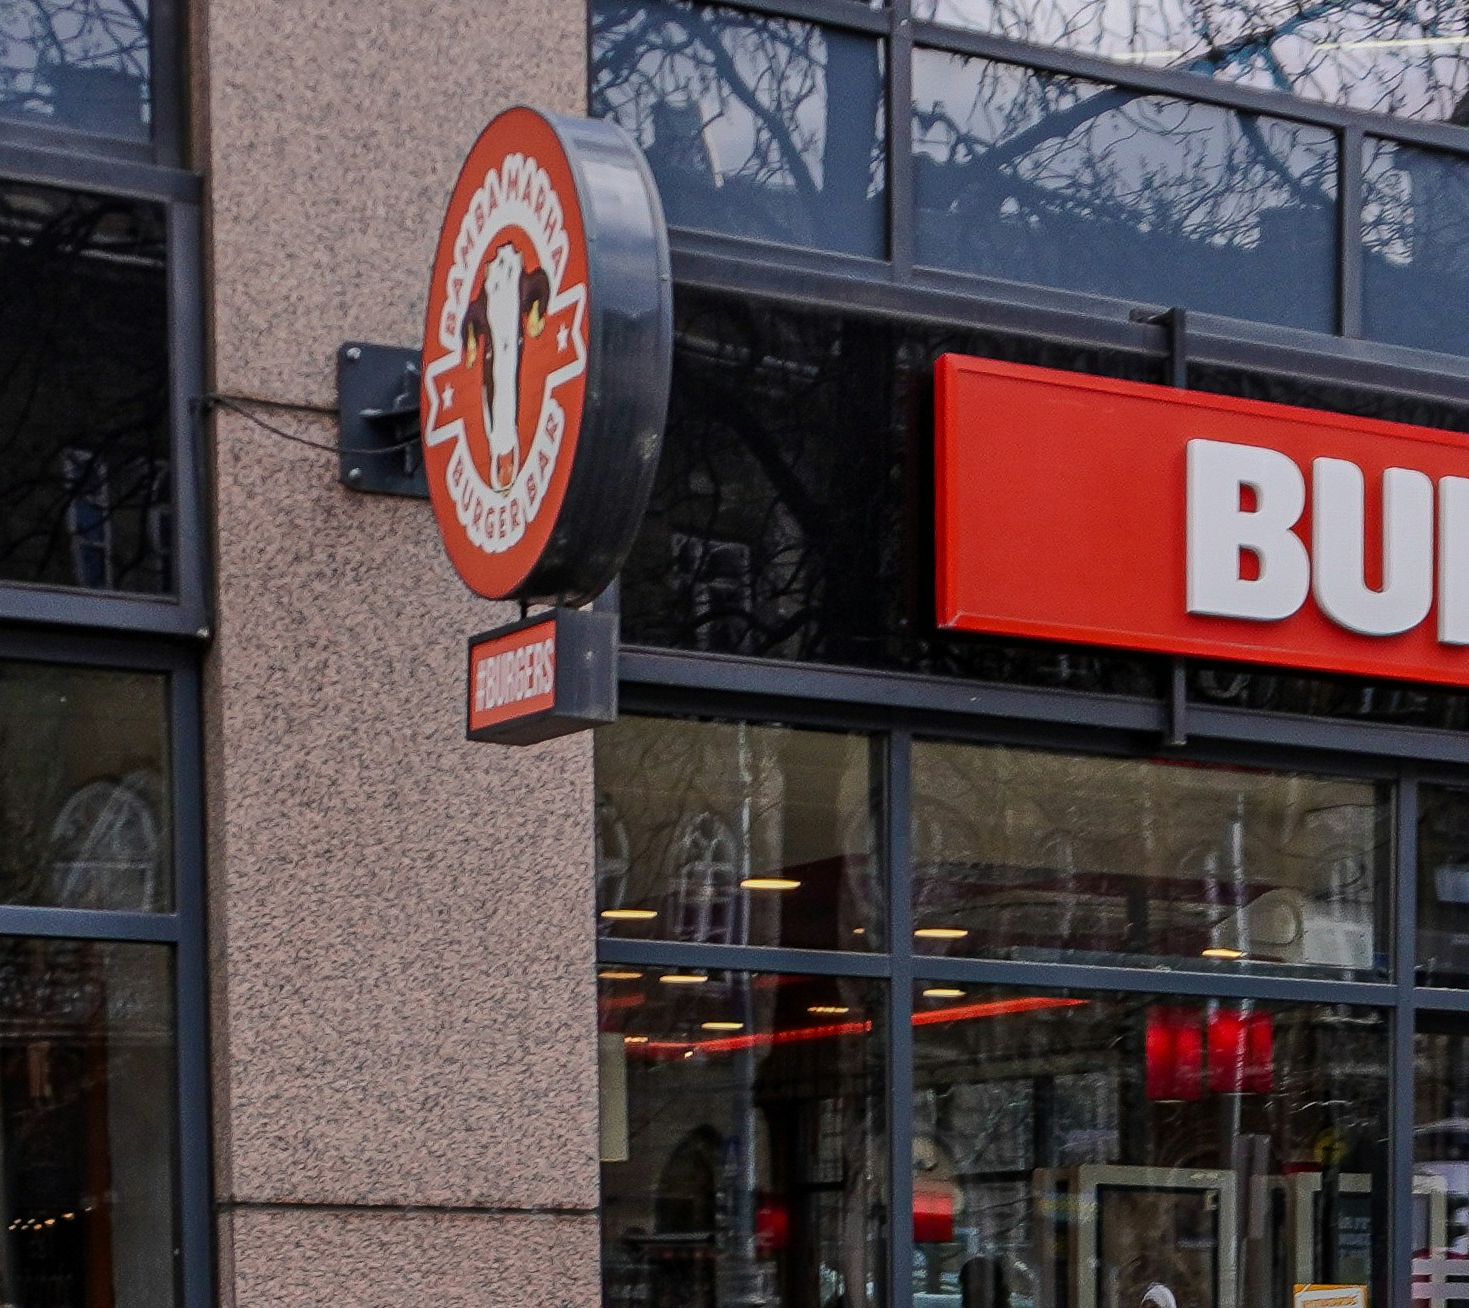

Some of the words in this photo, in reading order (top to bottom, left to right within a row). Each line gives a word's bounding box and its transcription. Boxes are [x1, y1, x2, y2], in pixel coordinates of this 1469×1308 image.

[445, 180, 498, 336] BAMBA
[506, 168, 564, 278] MARHA
[452, 456, 519, 540] BURGER
[526, 412, 559, 507] BAR
[475, 639, 554, 712] #BURGERS
